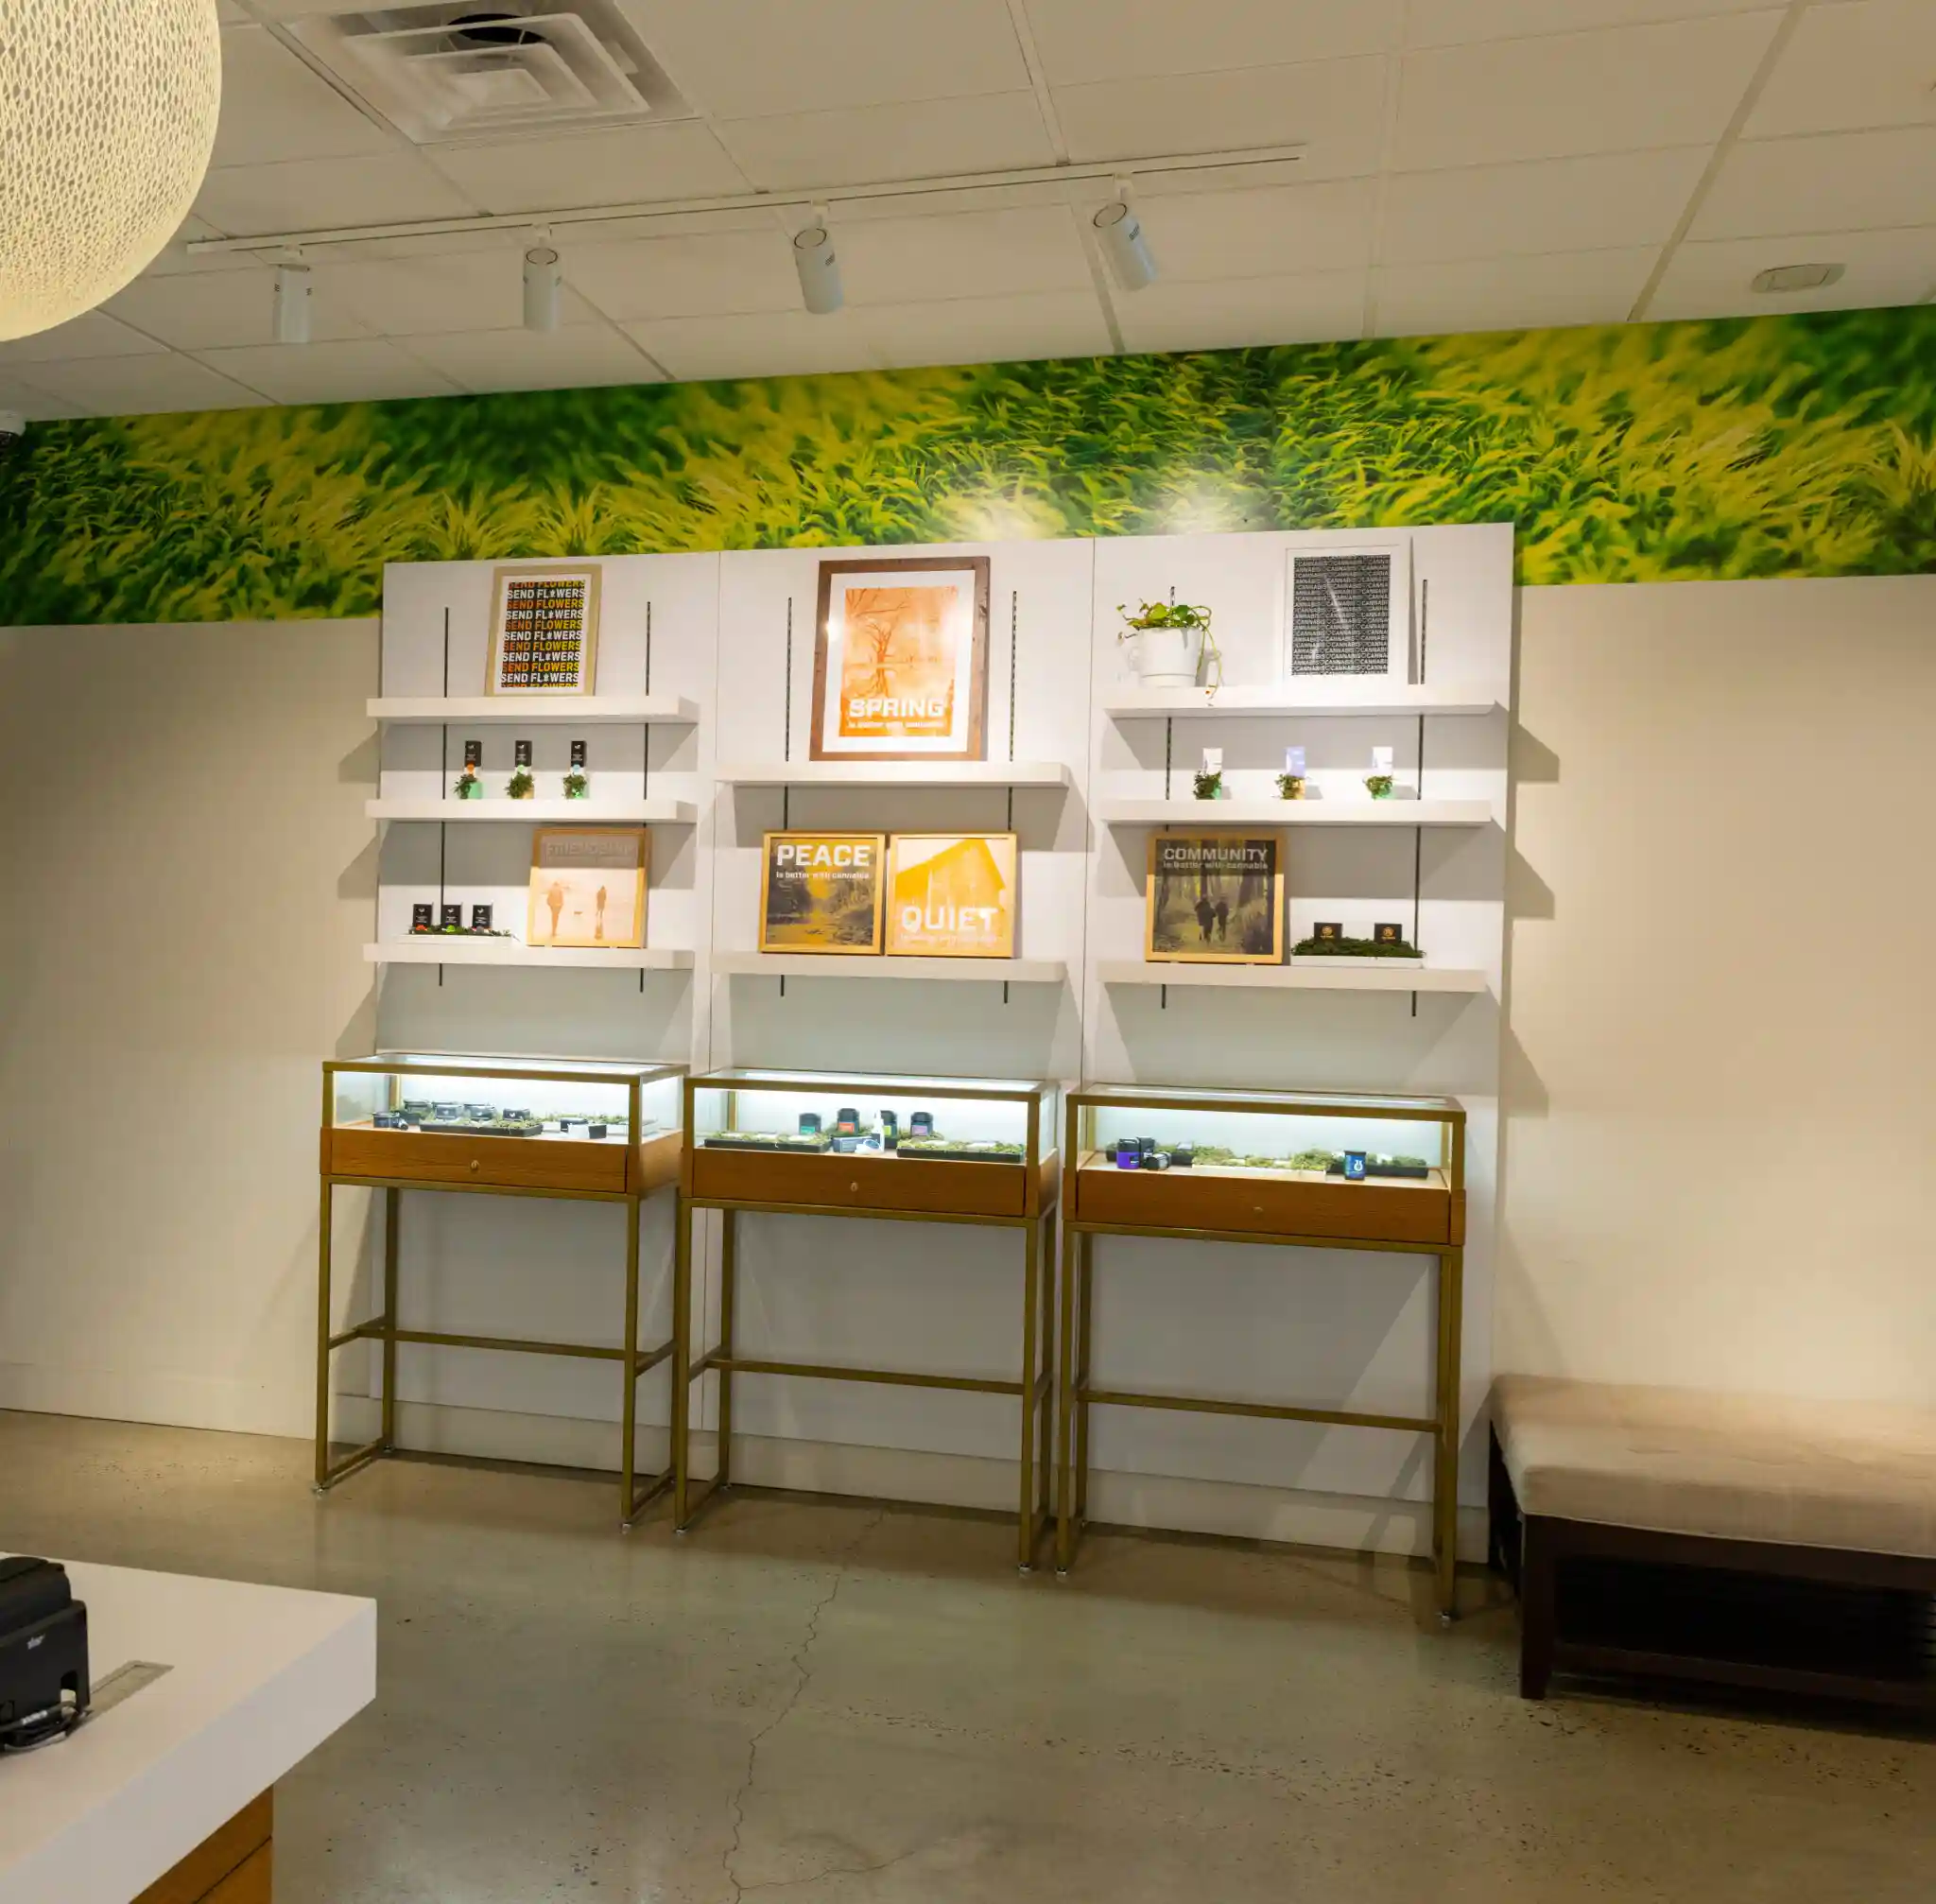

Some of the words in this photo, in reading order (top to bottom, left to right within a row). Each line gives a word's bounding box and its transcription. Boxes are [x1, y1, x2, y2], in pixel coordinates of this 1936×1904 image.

[508, 590, 534, 599] SEND
[507, 599, 533, 609] SEND
[536, 599, 584, 609] FLOWERS
[507, 611, 533, 620] SEND
[506, 621, 531, 631] SEND
[535, 620, 582, 630] FLOWERS
[505, 632, 531, 641] SEND
[504, 642, 530, 652] SEND
[533, 641, 580, 650] FLOWERS
[503, 652, 529, 662] SEND
[501, 663, 528, 672] SEND
[531, 662, 579, 671] FLOWERS
[501, 673, 528, 683] SEND
[849, 698, 945, 717] SPRING
[777, 845, 871, 866] PEACE
[1164, 848, 1268, 860] COMMUNITY
[902, 906, 998, 932] QUIET
